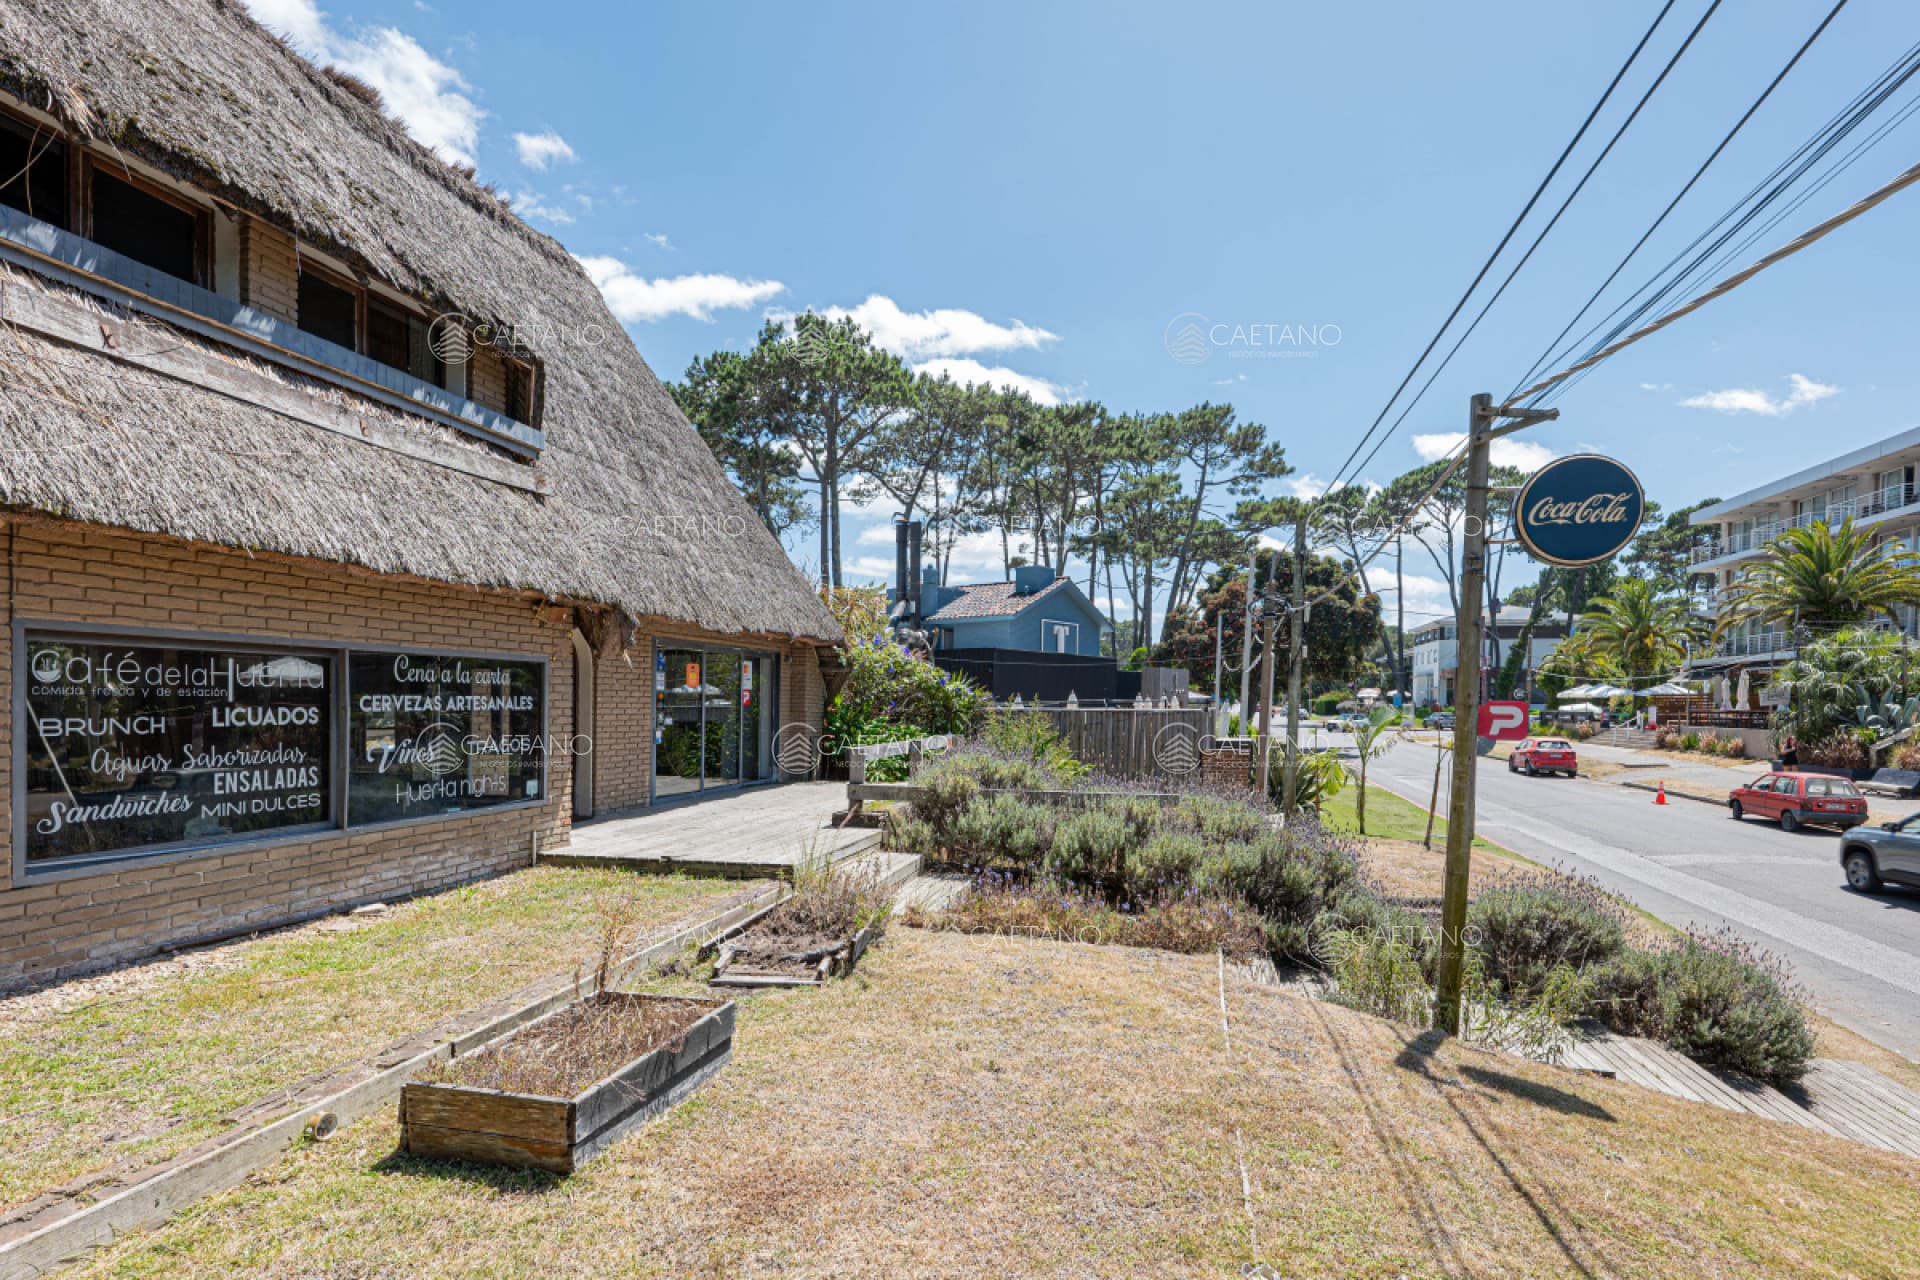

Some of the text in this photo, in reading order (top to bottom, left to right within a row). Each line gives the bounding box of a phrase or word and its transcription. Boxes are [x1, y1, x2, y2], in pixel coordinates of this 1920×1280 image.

[31, 649, 142, 685] Café
[394, 654, 512, 686] Cena a la carta
[156, 686, 171, 697] de
[359, 694, 534, 712] CERVEZAS ARTESANALES
[39, 716, 166, 737] BRUNCH
[212, 706, 319, 728] LICUADOS
[90, 742, 307, 782] Aguas Saborizadas
[213, 766, 319, 795] ENSALADAS
[396, 778, 457, 806] Huerta
[36, 791, 194, 834] Sandwiches
[201, 793, 321, 819] MINI DULCES
